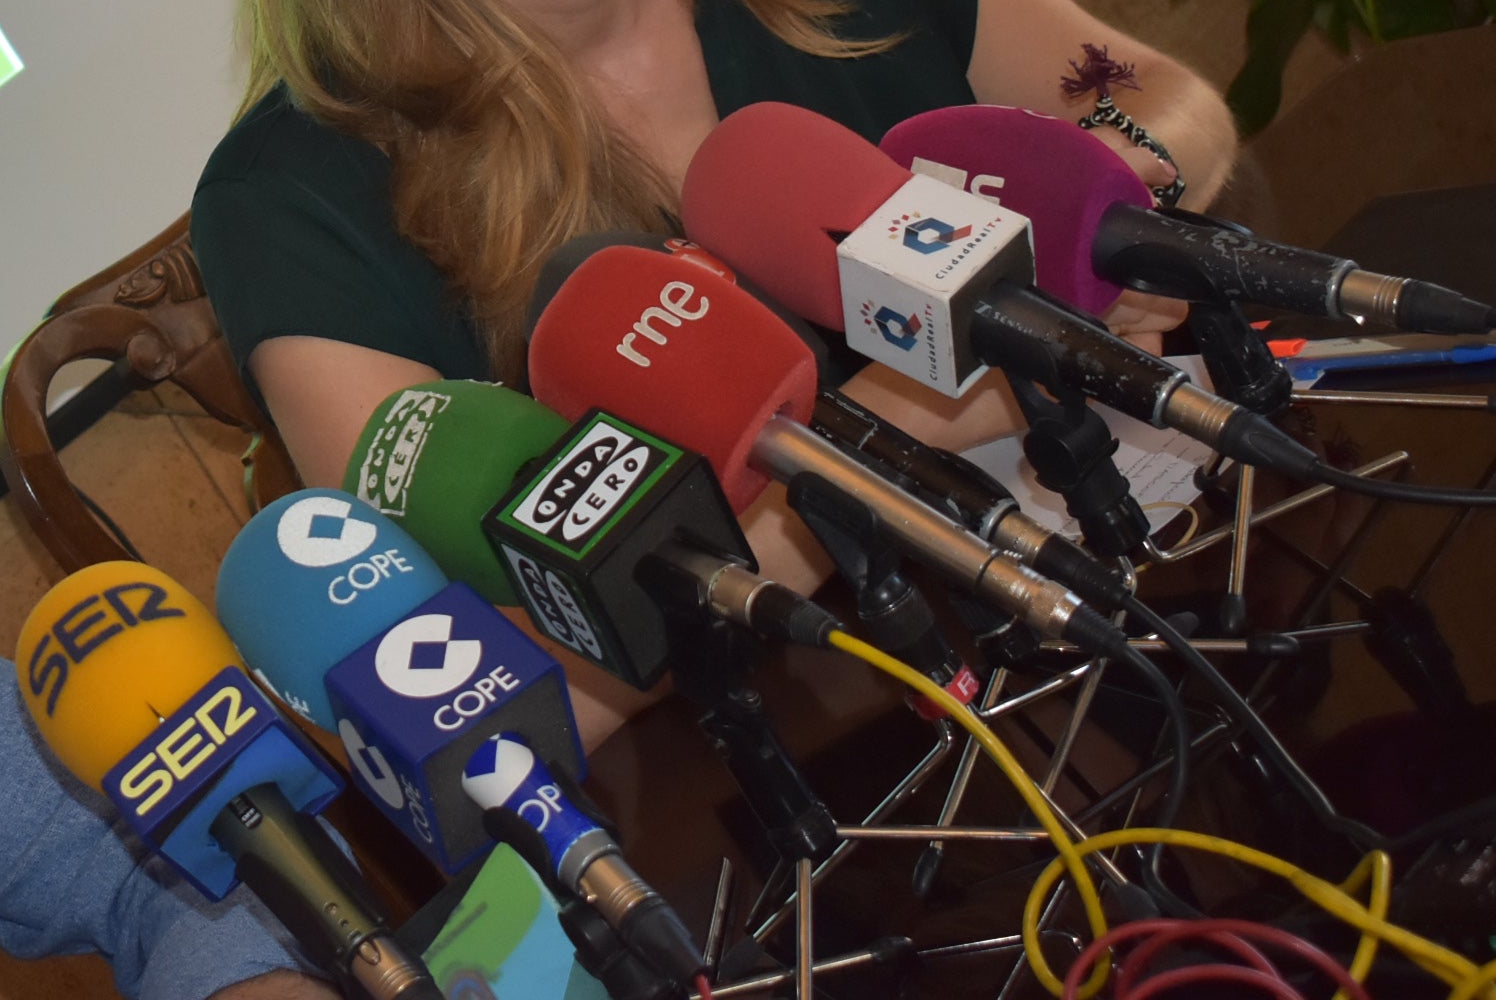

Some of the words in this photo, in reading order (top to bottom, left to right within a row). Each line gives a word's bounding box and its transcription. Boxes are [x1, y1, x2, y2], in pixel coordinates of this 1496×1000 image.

[616, 280, 710, 368] rne
[536, 444, 614, 517] ONDA
[571, 456, 640, 526] CERO
[328, 548, 414, 606] COPE
[28, 580, 187, 718] SER
[433, 665, 521, 731] COPE
[119, 685, 257, 817] SER
